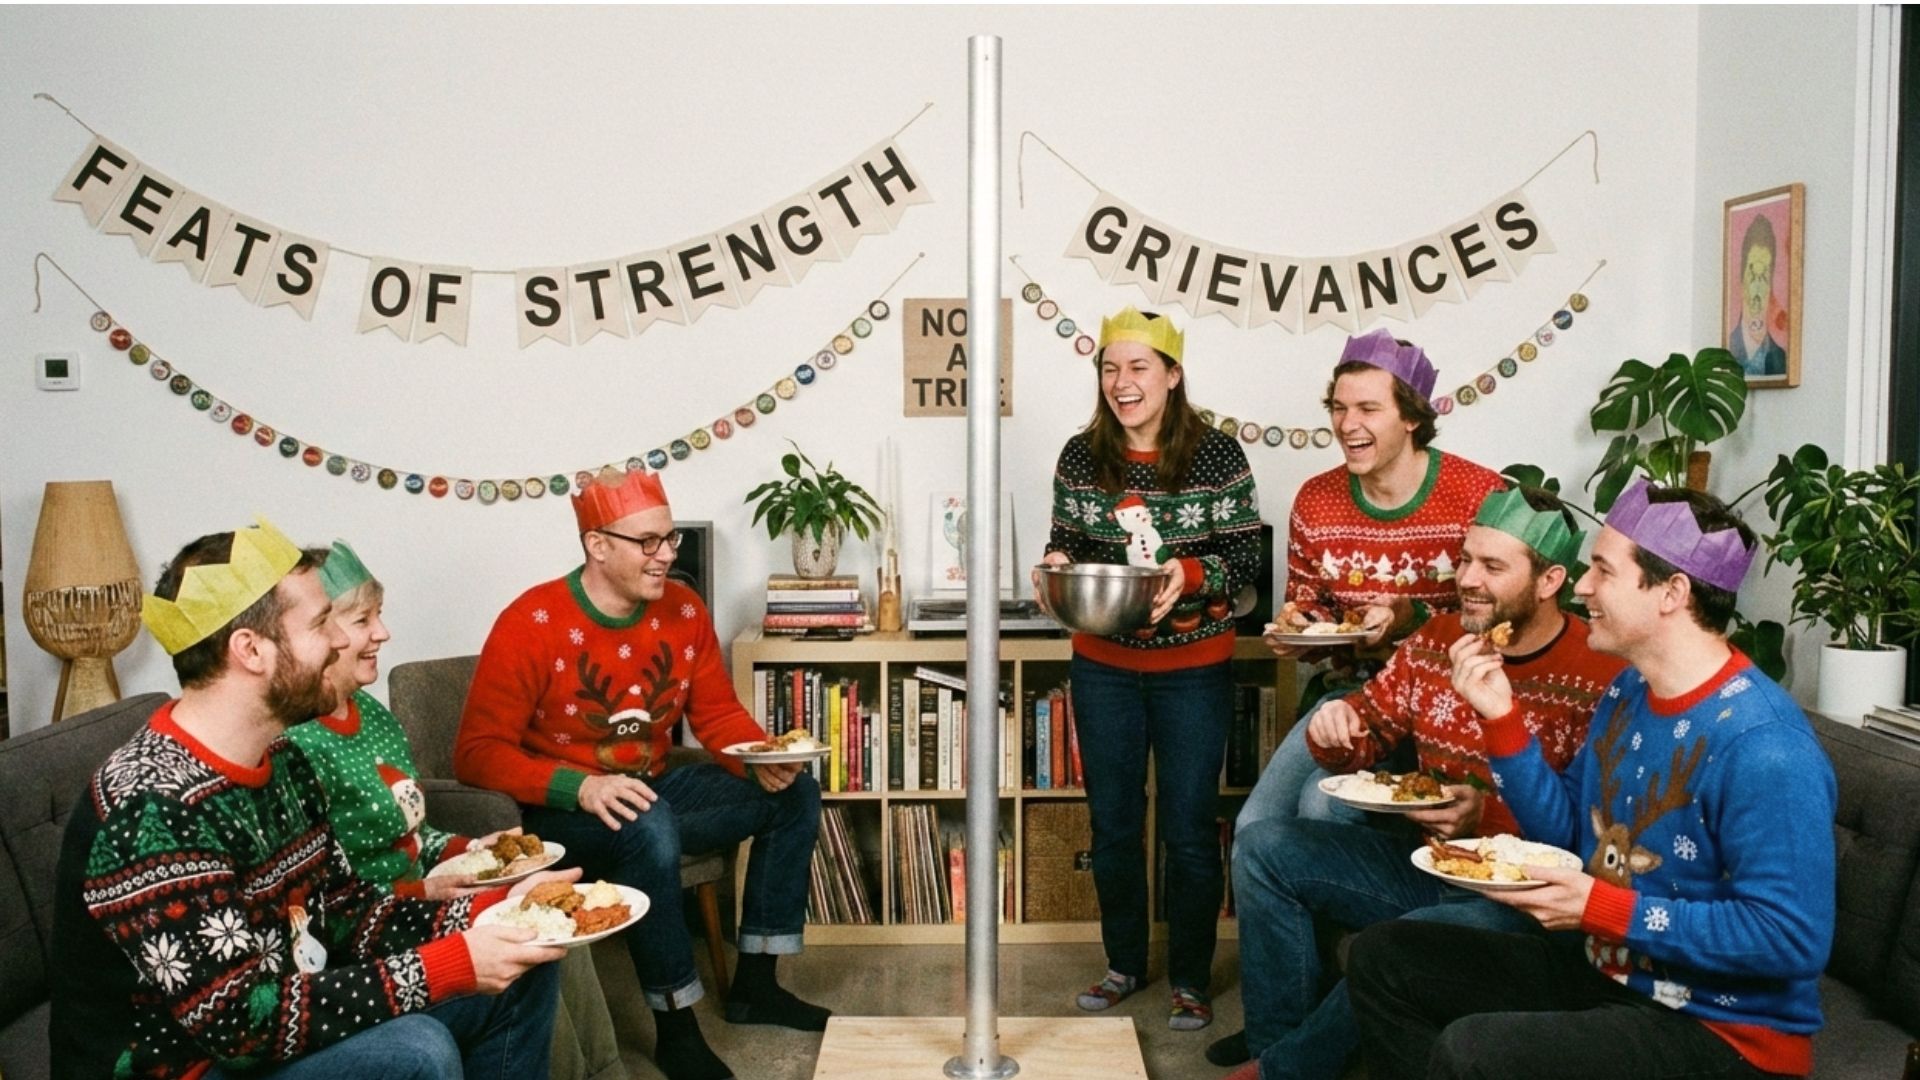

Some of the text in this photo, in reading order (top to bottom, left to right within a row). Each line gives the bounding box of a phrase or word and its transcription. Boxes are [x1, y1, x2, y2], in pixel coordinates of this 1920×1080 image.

[72, 145, 917, 327] FEATS OF STRENGTH
[1085, 202, 1538, 313] GRIEVANCES
[922, 308, 968, 337] NO
[946, 343, 968, 371] A
[912, 378, 1006, 407] TR
